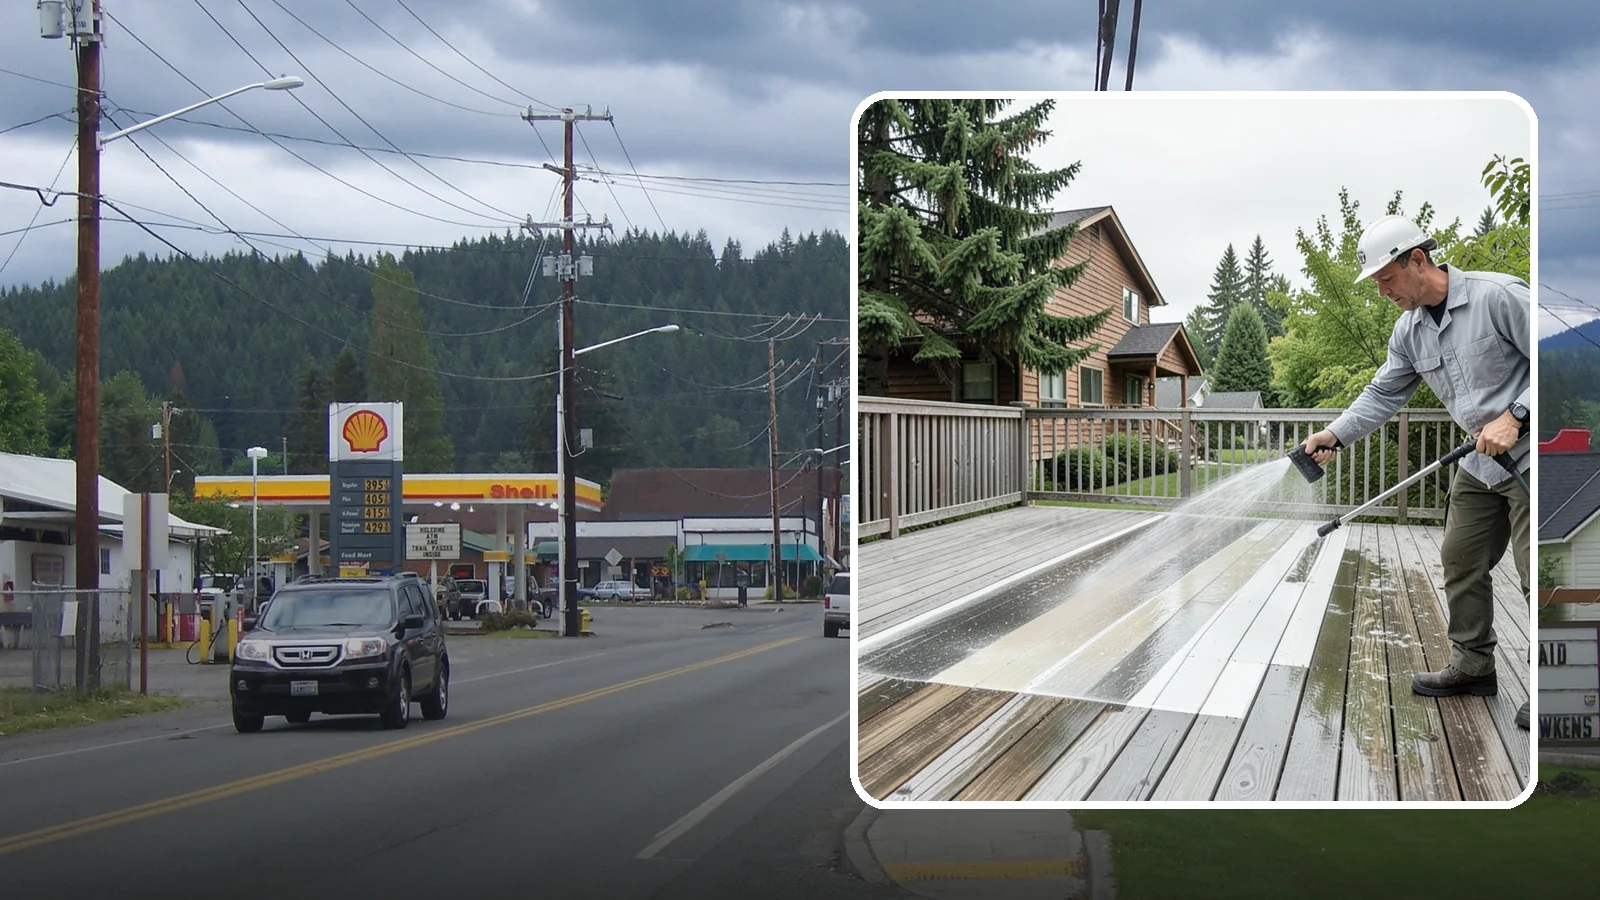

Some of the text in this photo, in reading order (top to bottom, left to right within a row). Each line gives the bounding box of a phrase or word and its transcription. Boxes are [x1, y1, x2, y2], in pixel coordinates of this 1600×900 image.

[366, 480, 383, 490] 395
[490, 484, 548, 499] Shell
[366, 494, 383, 504] 405
[365, 508, 383, 518] 415
[365, 522, 383, 533] 429
